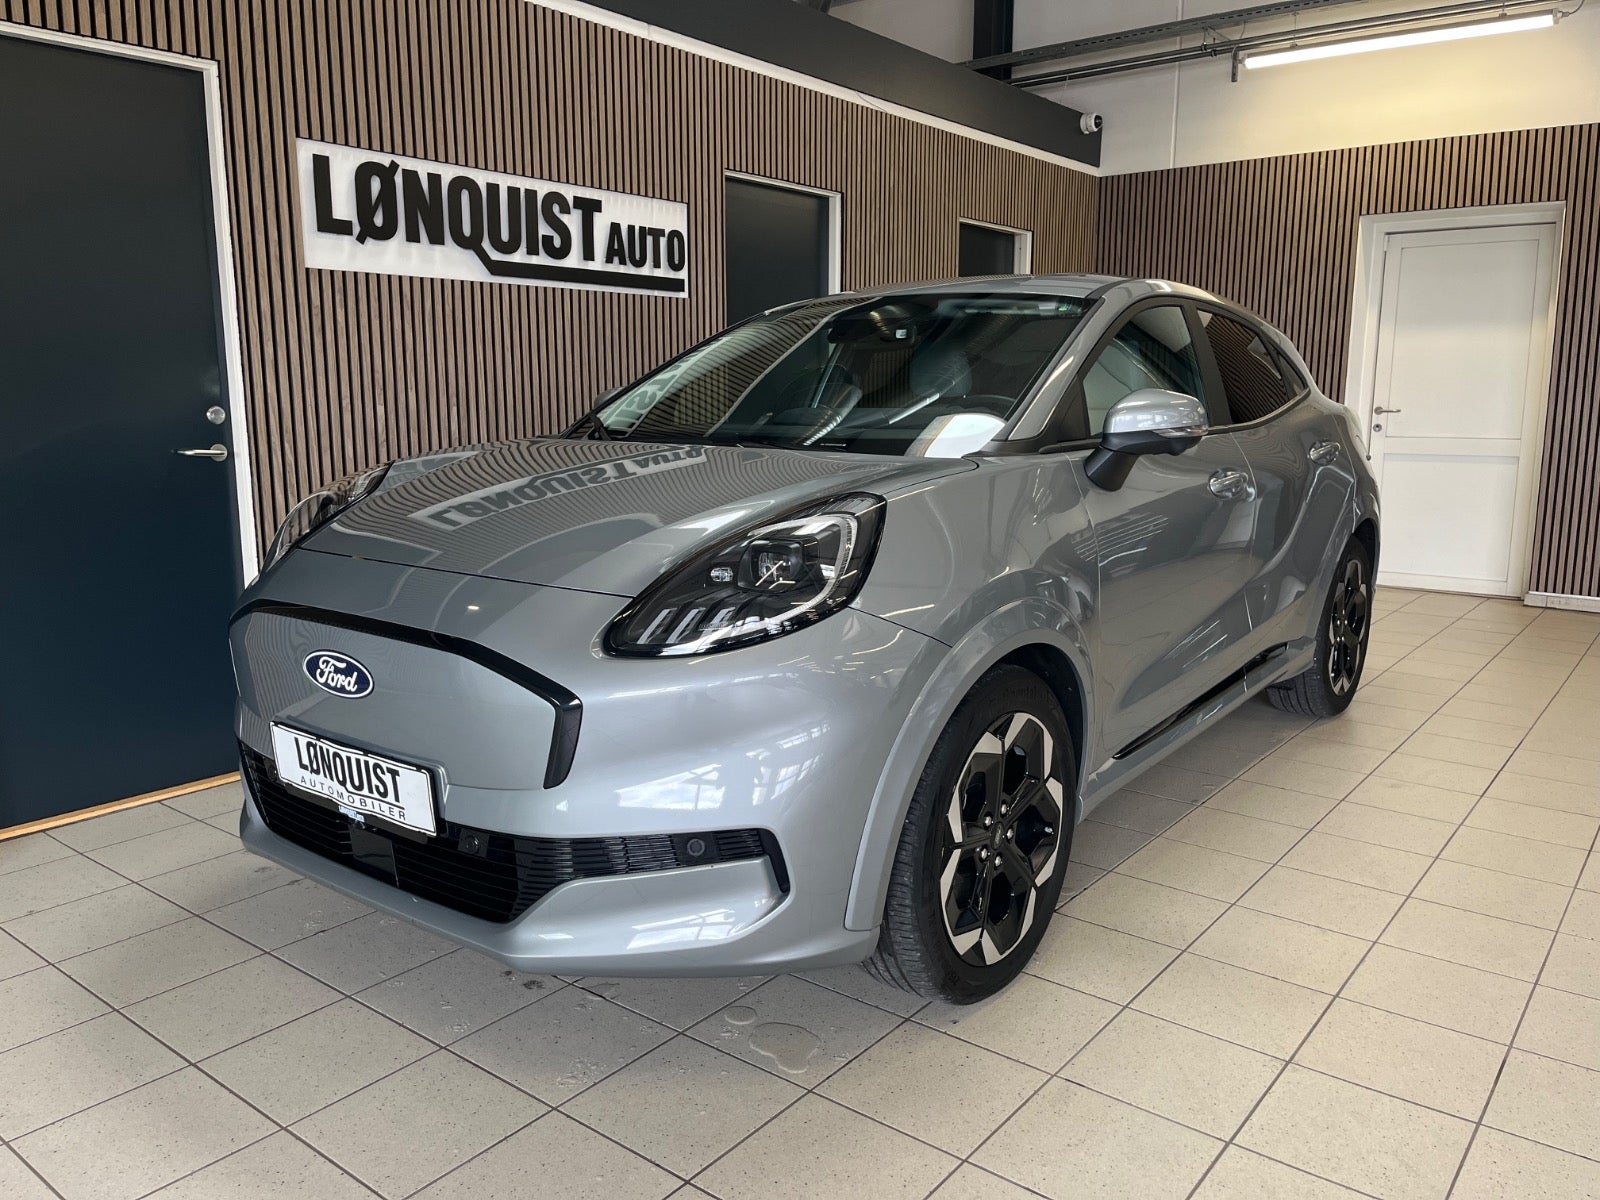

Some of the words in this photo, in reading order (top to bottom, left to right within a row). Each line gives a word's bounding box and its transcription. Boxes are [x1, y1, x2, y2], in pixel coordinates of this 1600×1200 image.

[312, 153, 602, 268] LØNQUIST
[605, 222, 686, 272] AUTO
[315, 656, 358, 692] Ford
[294, 737, 401, 803] LØNQUIST
[300, 775, 407, 821] AUTOMOBILER
